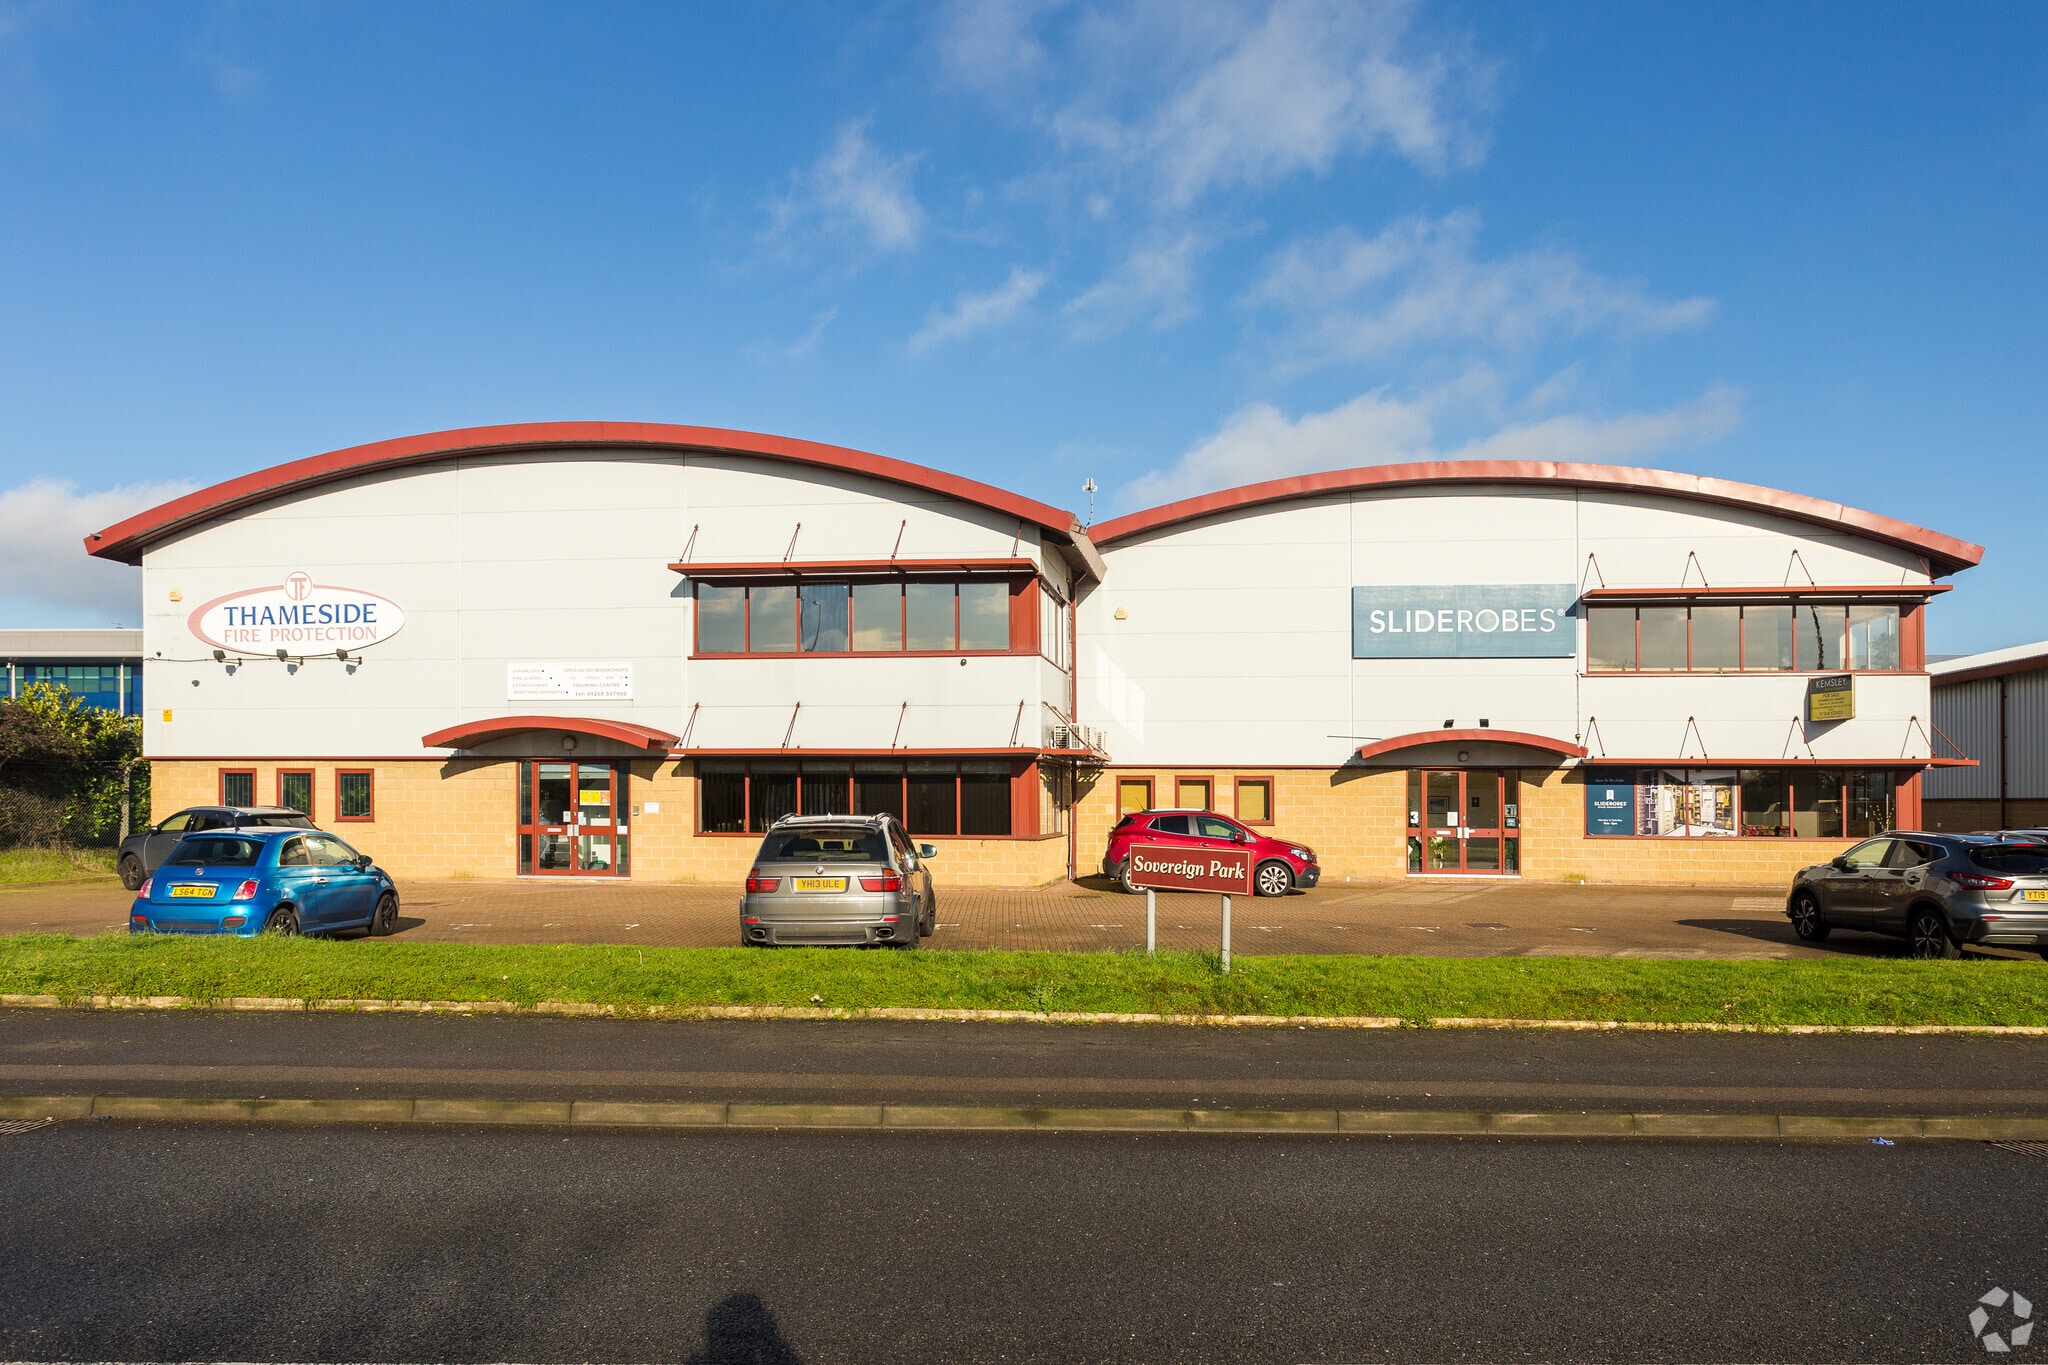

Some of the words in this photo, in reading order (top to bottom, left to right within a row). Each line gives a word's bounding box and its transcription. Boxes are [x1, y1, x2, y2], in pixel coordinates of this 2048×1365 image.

[223, 603, 377, 626] THAMESIDE
[224, 628, 262, 643] FIRE
[270, 626, 377, 642] PROTECTION
[1816, 678, 1846, 688] KEMSLEY
[1410, 811, 1419, 824] 3
[1133, 855, 1205, 880] Sovereign
[1209, 860, 1246, 880] Park
[801, 879, 821, 888] YH13
[822, 879, 840, 888] ULE
[173, 888, 195, 896] LS64
[197, 888, 215, 896] TGN
